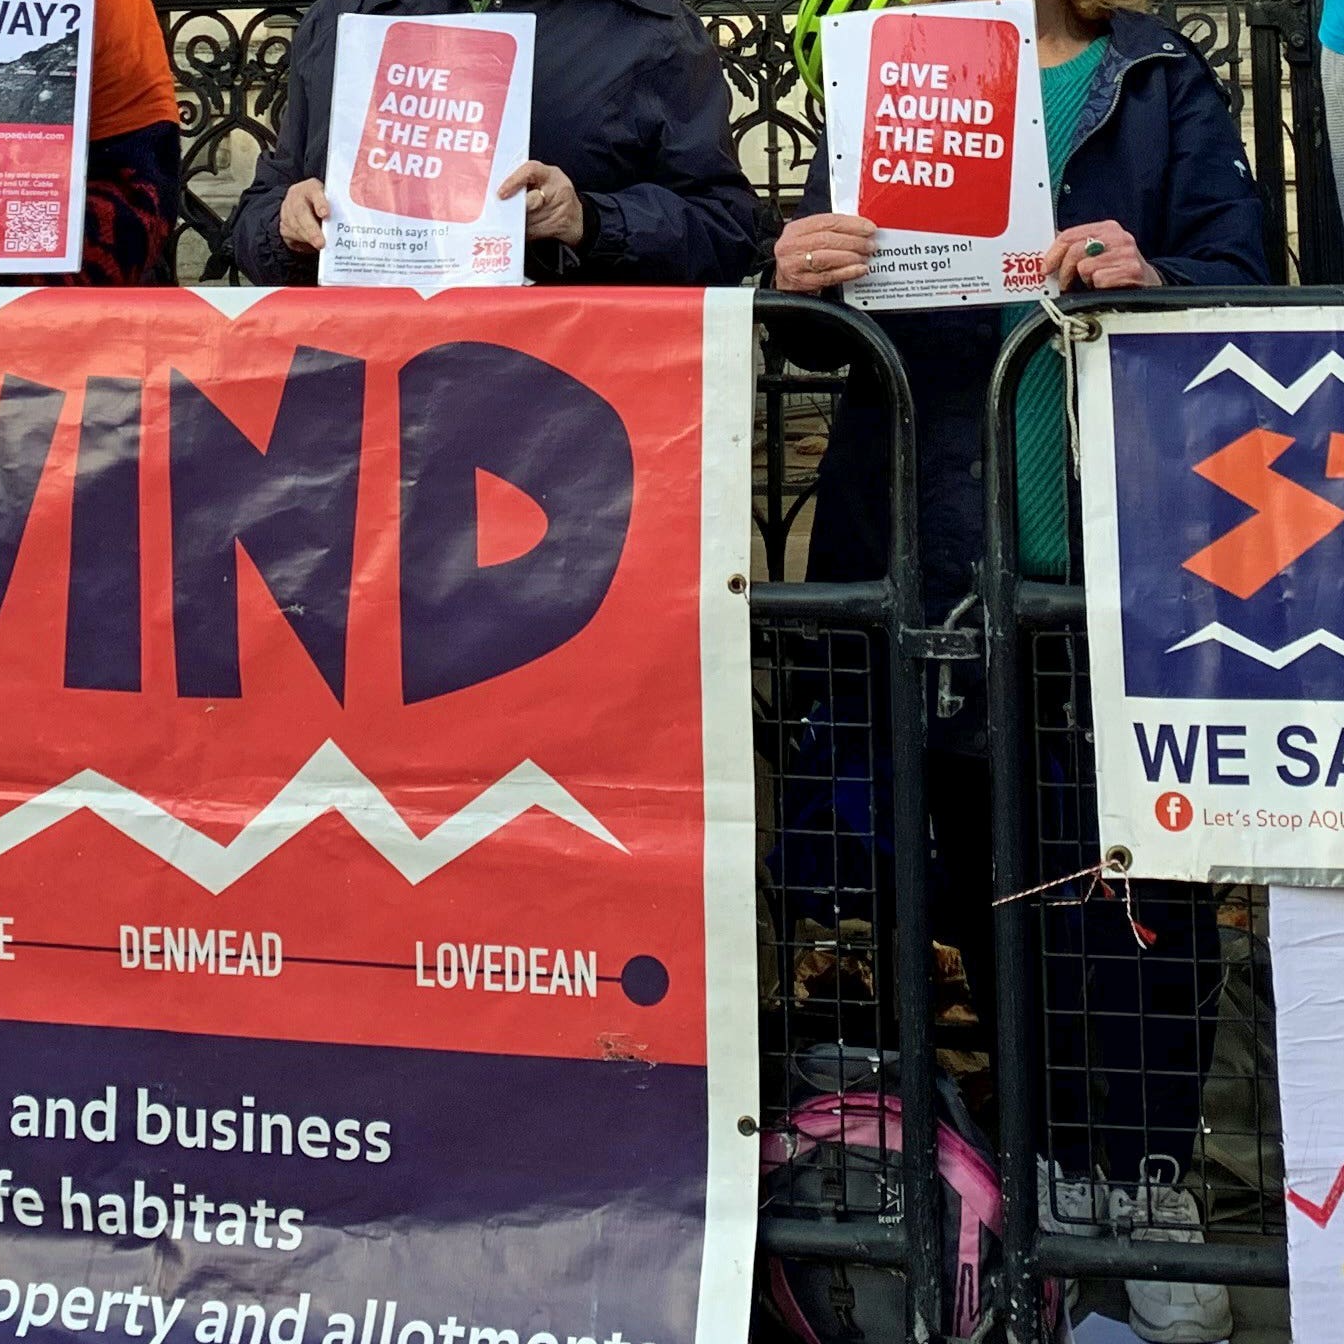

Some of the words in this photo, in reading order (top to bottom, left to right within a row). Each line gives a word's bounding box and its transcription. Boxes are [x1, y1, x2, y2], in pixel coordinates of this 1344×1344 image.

[387, 64, 451, 91] GIVE
[879, 61, 949, 90] GIVE
[378, 92, 484, 124] AQUIND
[875, 94, 994, 125] AQUIND
[375, 119, 427, 148] THE
[435, 128, 489, 153] RED
[875, 125, 934, 154] THE
[943, 132, 1004, 160] RED
[367, 148, 443, 179] CARD
[871, 158, 955, 189] CARD
[335, 236, 376, 250] Aquind
[379, 241, 407, 251] must
[409, 241, 428, 254] go!
[337, 223, 402, 237] Portsmouth
[405, 228, 428, 239] says
[472, 242, 512, 256] STOP
[472, 257, 511, 269] AQUIND
[924, 243, 950, 256] says
[952, 240, 973, 253] no!
[898, 260, 929, 273] must
[931, 258, 952, 273] go!
[1003, 274, 1046, 288] AQUIND
[1133, 722, 1250, 785] WE
[1203, 807, 1251, 828] Let's
[1256, 809, 1303, 832] Stop
[120, 925, 283, 978] DENMEAD
[415, 941, 598, 998] LOVEDEAN
[10, 1086, 118, 1142] and
[136, 1088, 392, 1163] business
[60, 1176, 306, 1251] habitats
[195, 1292, 311, 1344] and
